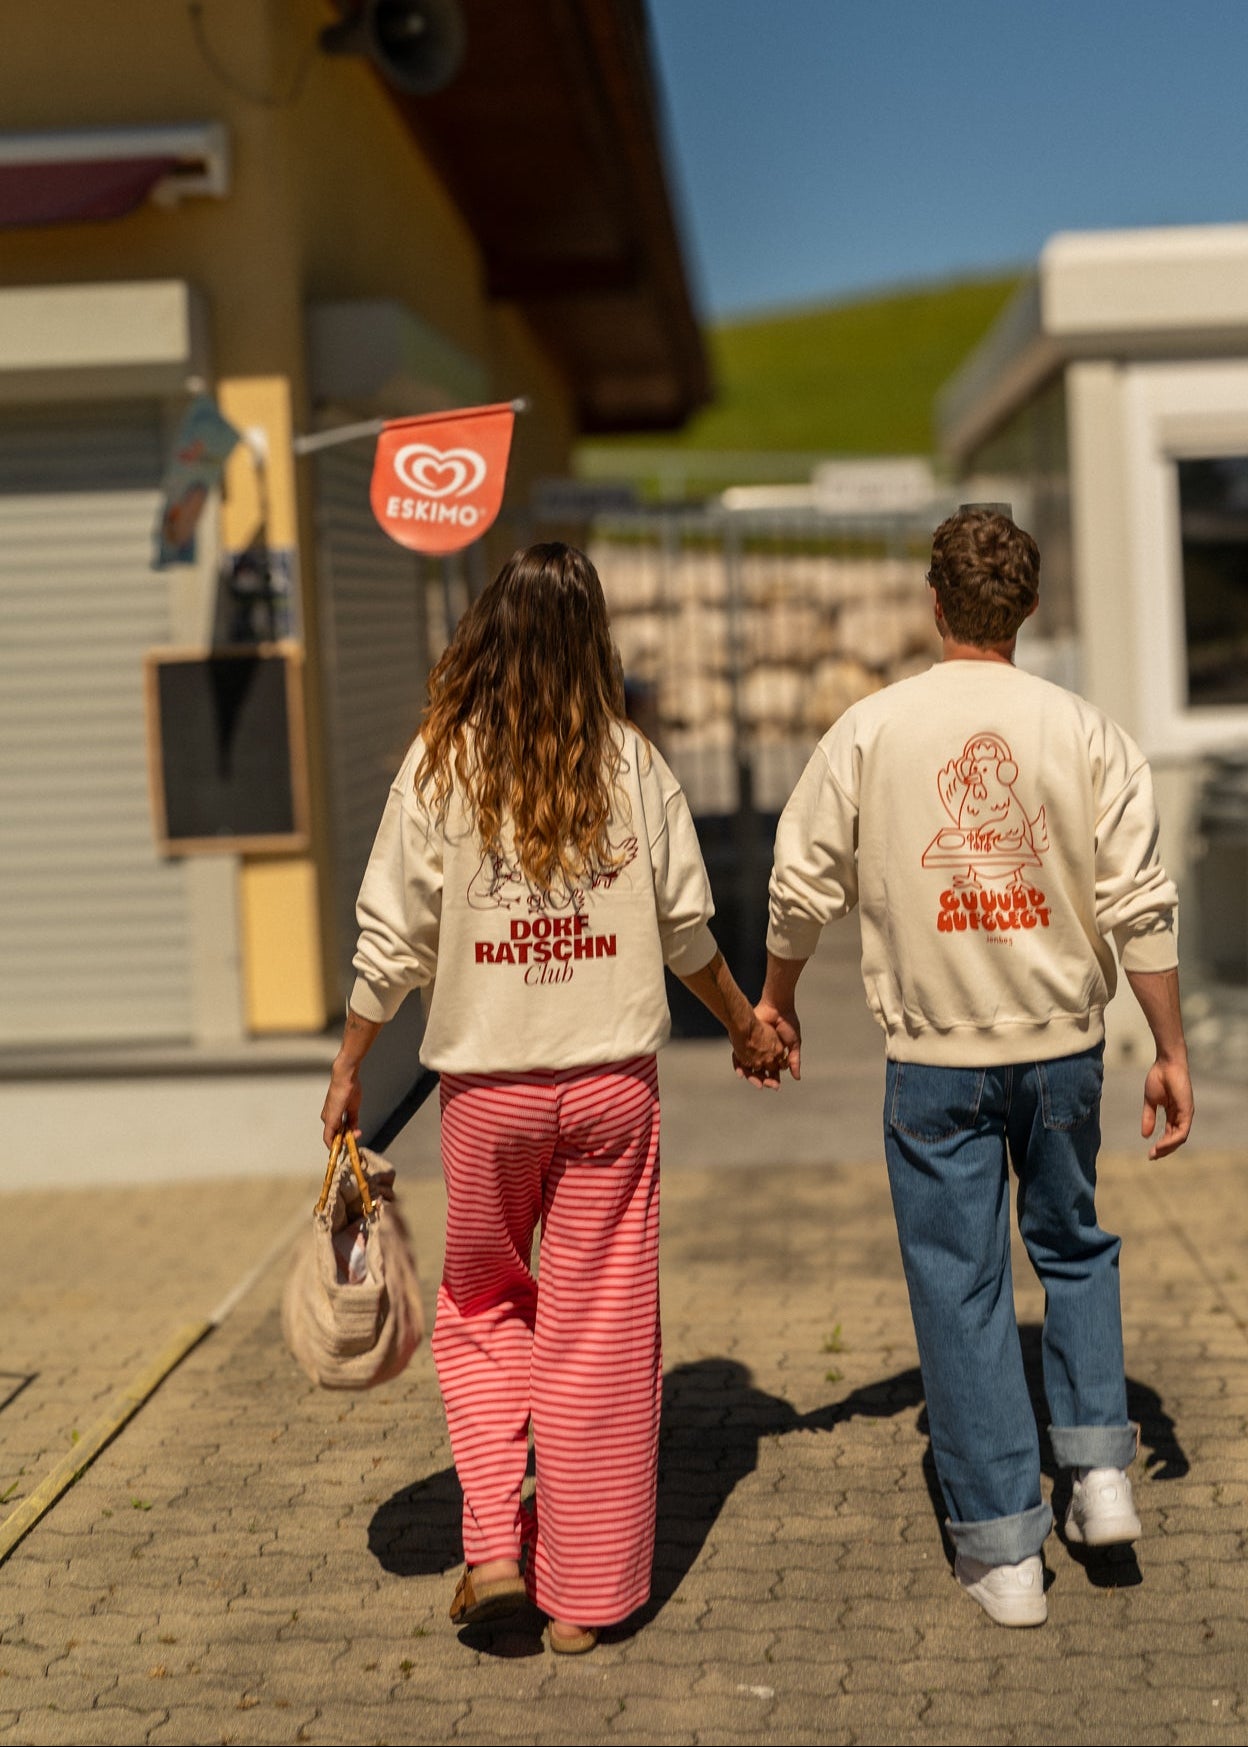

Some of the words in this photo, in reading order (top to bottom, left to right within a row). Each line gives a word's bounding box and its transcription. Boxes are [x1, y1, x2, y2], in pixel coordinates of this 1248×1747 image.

[386, 496, 478, 527] ESKIMO
[510, 914, 589, 940] DORF
[475, 934, 617, 964] RATSCHN
[524, 960, 574, 986] Club
